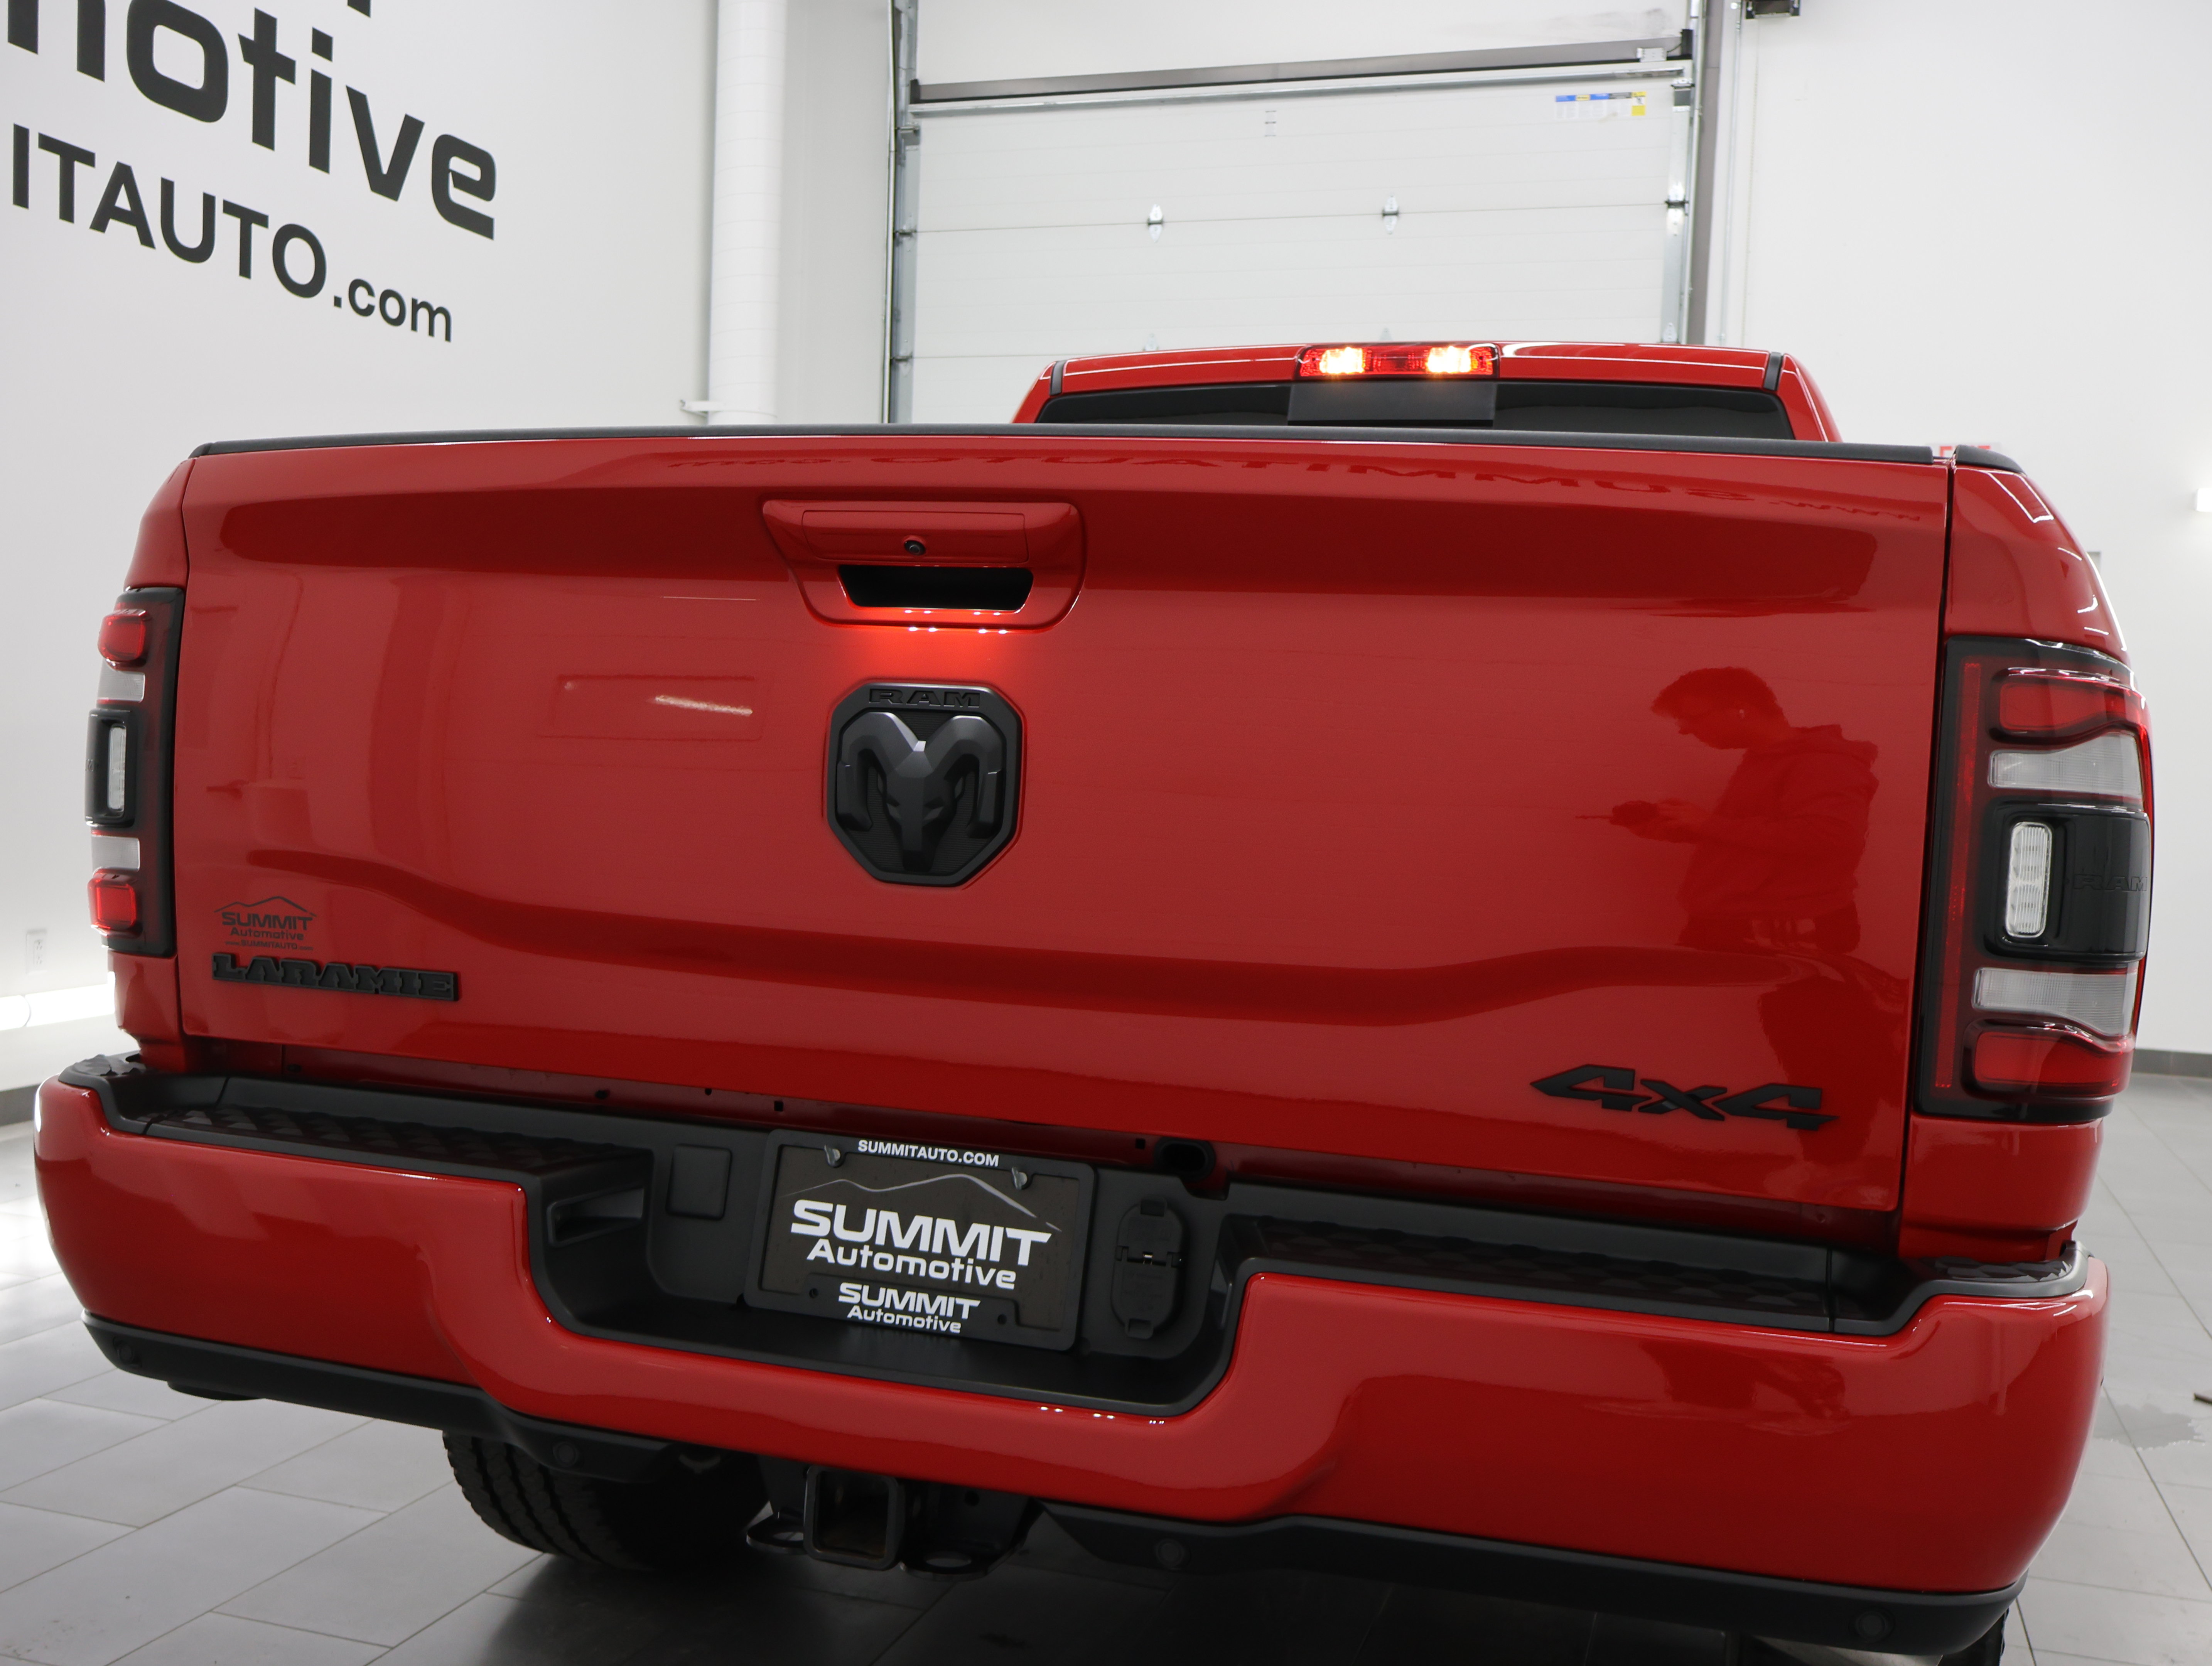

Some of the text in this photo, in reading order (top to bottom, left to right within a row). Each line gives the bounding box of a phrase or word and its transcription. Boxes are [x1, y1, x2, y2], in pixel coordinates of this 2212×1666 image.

[869, 688, 980, 709] RAM
[2073, 874, 2148, 892] RAM
[222, 912, 313, 931] SUMMIT
[230, 927, 304, 941] Automotive
[225, 939, 313, 951] www.SUMMITAUTO.com
[212, 952, 459, 1002] LARAMIE
[858, 1140, 999, 1167] SUMMITAUTO.COM
[791, 1199, 1052, 1266] SUMMIT
[807, 1238, 1016, 1290] Automotive
[838, 1282, 981, 1319] SUMMIT
[847, 1305, 961, 1333] Automotive
